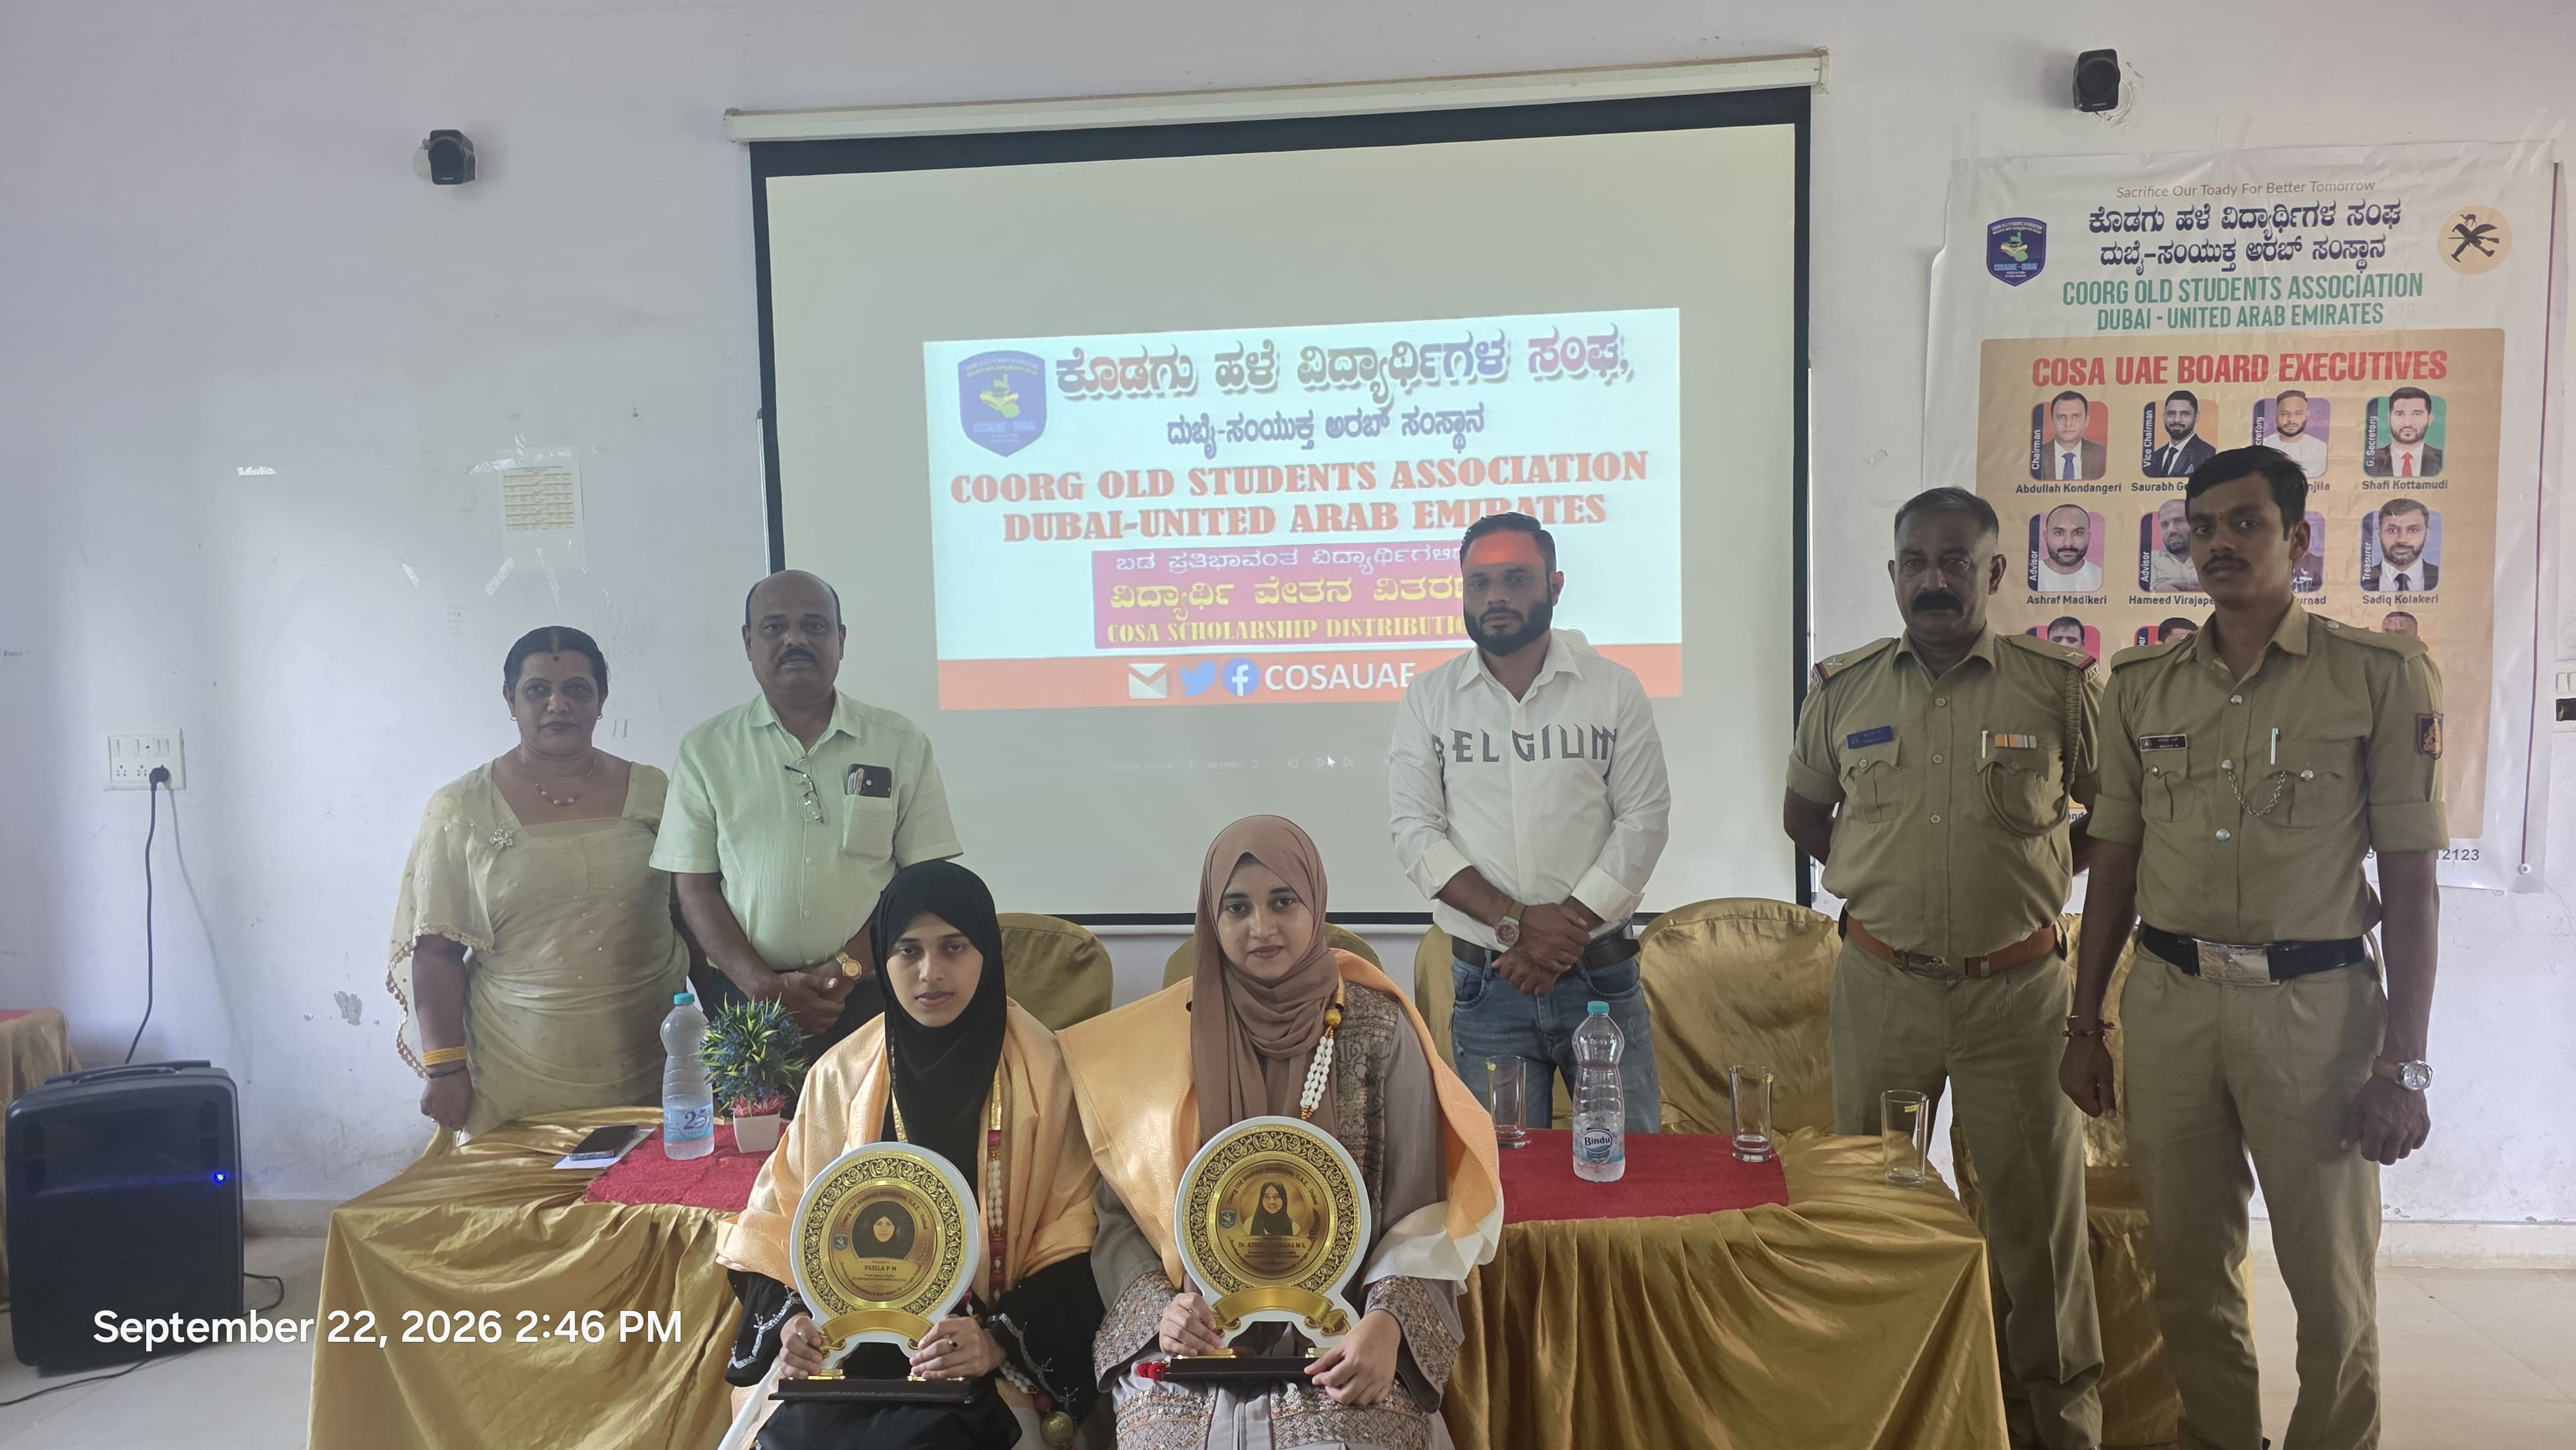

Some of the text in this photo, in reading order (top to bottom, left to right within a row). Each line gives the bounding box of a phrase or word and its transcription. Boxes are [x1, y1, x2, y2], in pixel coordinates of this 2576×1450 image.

[2116, 181, 2376, 198] Sacrifice Our Toady For Better Tomorrow
[2088, 197, 2401, 241] ಕೊಡಗು ಹಳೆ ವಿದ್ಯಾರ್ಥಿಗಳ ಸಂಘ
[2246, 235, 2302, 262] ಅರಬ್
[2312, 233, 2386, 274] ಸಂಸ್ಥಾನ
[2063, 272, 2423, 306] COORG OLD STUDENTS ASSOCIATION
[2097, 308, 2151, 330] DUBAI
[2167, 306, 2231, 328] UNITED
[2236, 305, 2286, 328] ARAB
[2291, 303, 2384, 326] EMIRATES
[1056, 343, 1197, 398] ಕೊಡಗು
[1215, 339, 1278, 393] ಹಳೆ
[1296, 328, 1510, 410] ವಿದ್ಯಾರ್ಥಿಗಳ
[2032, 350, 2447, 386] COSA UAE BOARD EXECUTIVES
[1325, 408, 1390, 439] ಅರಬ್
[1400, 400, 1485, 453] ಸಂಸ್ಥಾನ
[2143, 410, 2153, 447] Chairman
[2031, 429, 2041, 469] Chairman
[950, 451, 1649, 505] COORG OLD STUDENTS ASSOCIATION
[2016, 483, 2121, 494] Abdullah Kondangeri
[2131, 482, 2174, 492] Saurabh
[2362, 480, 2448, 489] Shafi Kottamudi
[1003, 494, 1607, 543] DUBAI-UNITED ARAB EMIRATES
[2029, 551, 2038, 581] Advisor
[2140, 551, 2150, 582] Advisor
[2362, 542, 2372, 581] Treasurer
[1110, 581, 1235, 621] ವಿದ್ಯಾರ್ಥಿ
[1255, 574, 1352, 606] ವೇತನ
[2027, 595, 2107, 605] Ashraf Madikeri
[2129, 595, 2215, 607] Hameed Virajape
[2362, 594, 2439, 606] Sadiq Kolakeri
[1108, 622, 1159, 644] COSA
[1167, 619, 1318, 643] SCHOLARSHIP
[1265, 662, 1416, 691] COSAUAE
[1432, 724, 1618, 767] BELGIUM
[1584, 1136, 1610, 1146] Bindu
